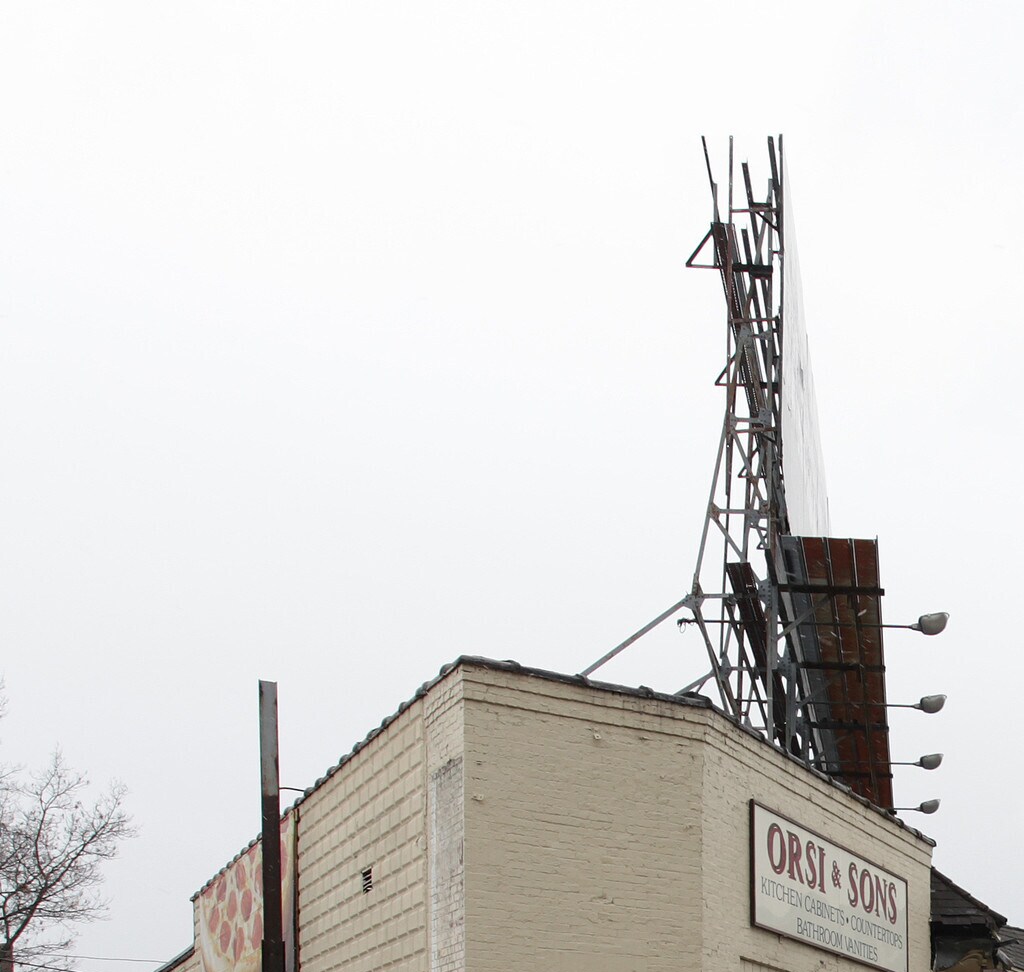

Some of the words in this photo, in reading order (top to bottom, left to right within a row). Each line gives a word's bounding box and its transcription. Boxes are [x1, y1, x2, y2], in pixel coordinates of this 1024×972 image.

[767, 823, 826, 894] ORSI
[831, 860, 842, 889] &
[848, 862, 897, 925] SONS
[761, 876, 802, 908] KITCHEN
[804, 895, 845, 926] CABINETS
[851, 915, 903, 950] COUNTERTOPS
[796, 917, 843, 950] BATHROOM
[844, 937, 878, 962] VANITIES
